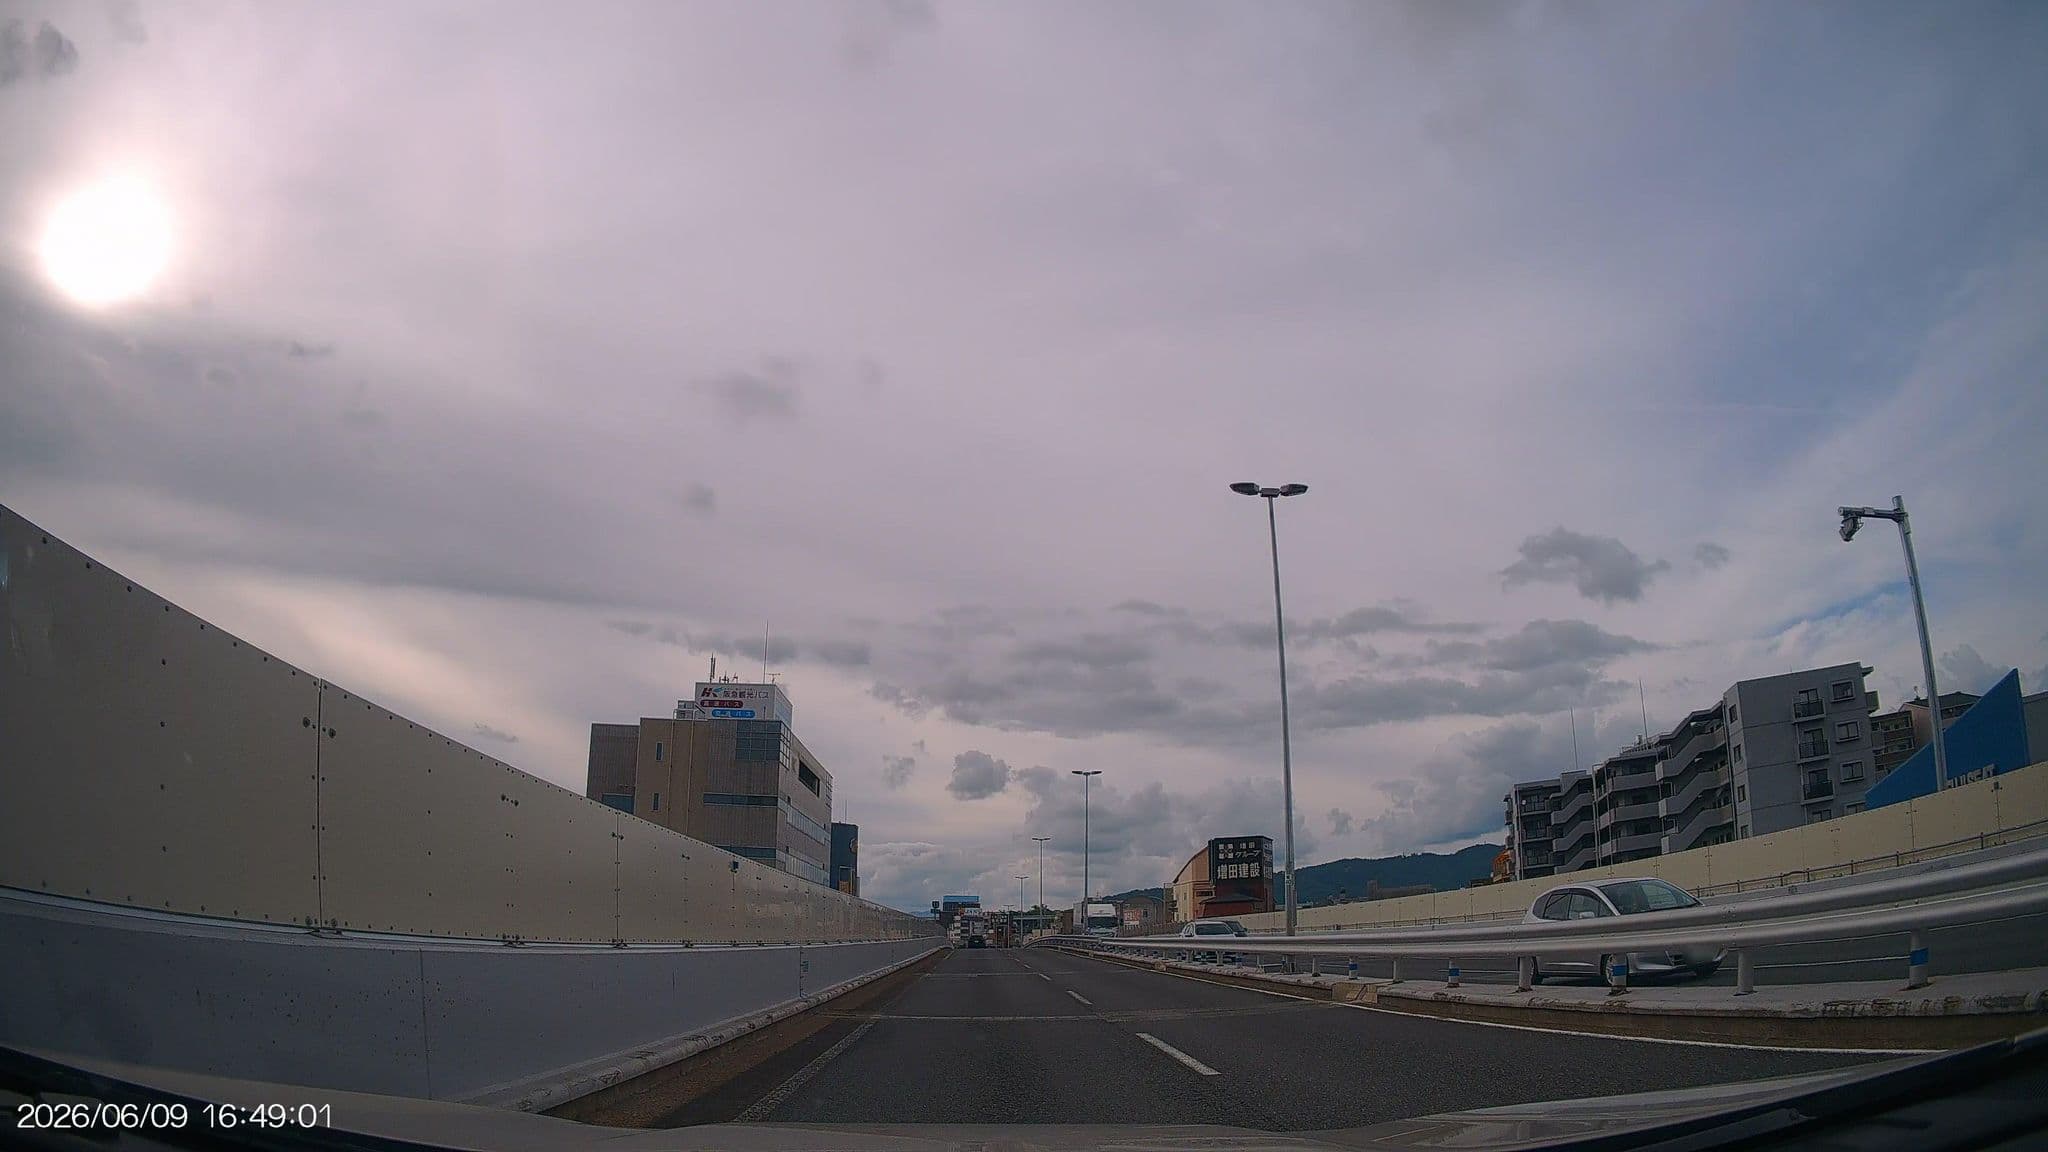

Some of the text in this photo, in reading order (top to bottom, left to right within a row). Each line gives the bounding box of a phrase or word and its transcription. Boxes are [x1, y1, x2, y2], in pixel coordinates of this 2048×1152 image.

[1235, 850, 1261, 858] グループ
[1217, 862, 1260, 880] 増田建設
